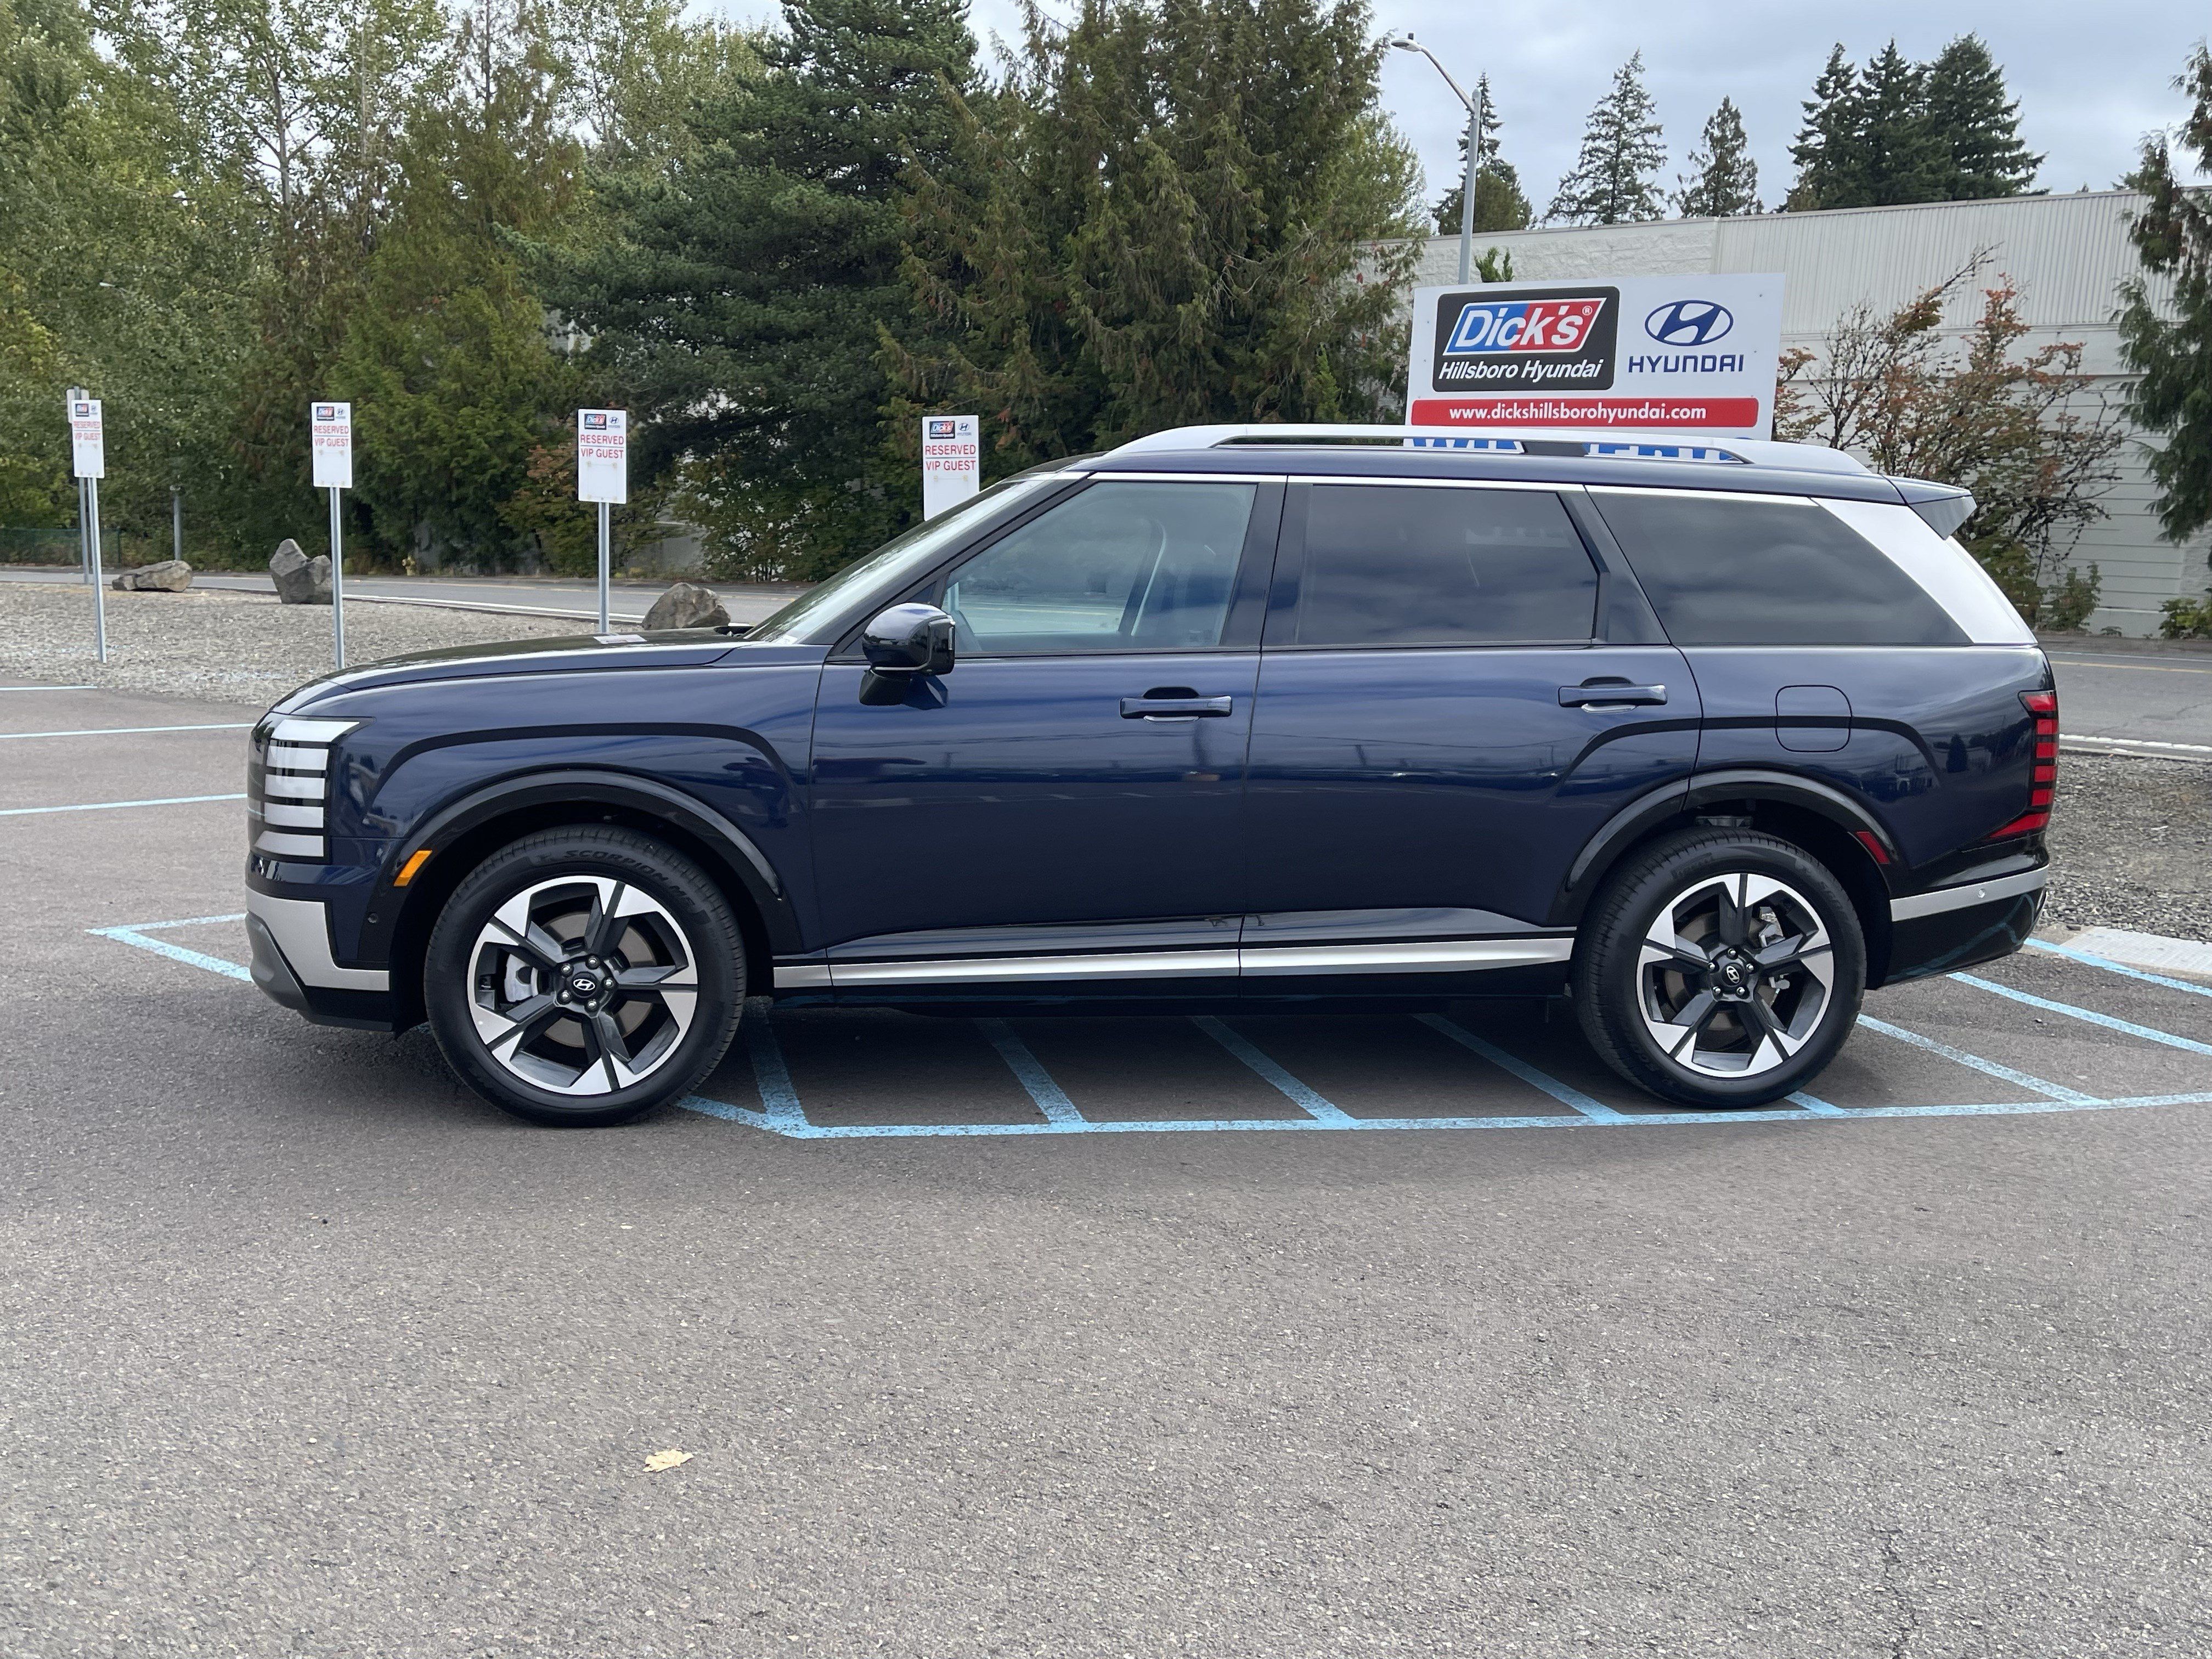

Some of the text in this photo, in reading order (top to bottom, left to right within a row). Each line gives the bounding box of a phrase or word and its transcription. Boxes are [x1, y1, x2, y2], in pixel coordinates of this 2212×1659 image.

[1628, 354, 1744, 373] HYUNDAI
[1438, 359, 1604, 383] Hillsboro Hyundai
[1449, 402, 1707, 423] www.dickshillsborohyundai.com
[313, 425, 349, 434] RESERVED
[314, 438, 349, 447] VIP GUEST
[580, 434, 624, 445] RESERVED
[580, 448, 624, 459] VIP GUEST
[925, 444, 977, 455] RESERVED
[926, 460, 977, 471] VIP GUEST
